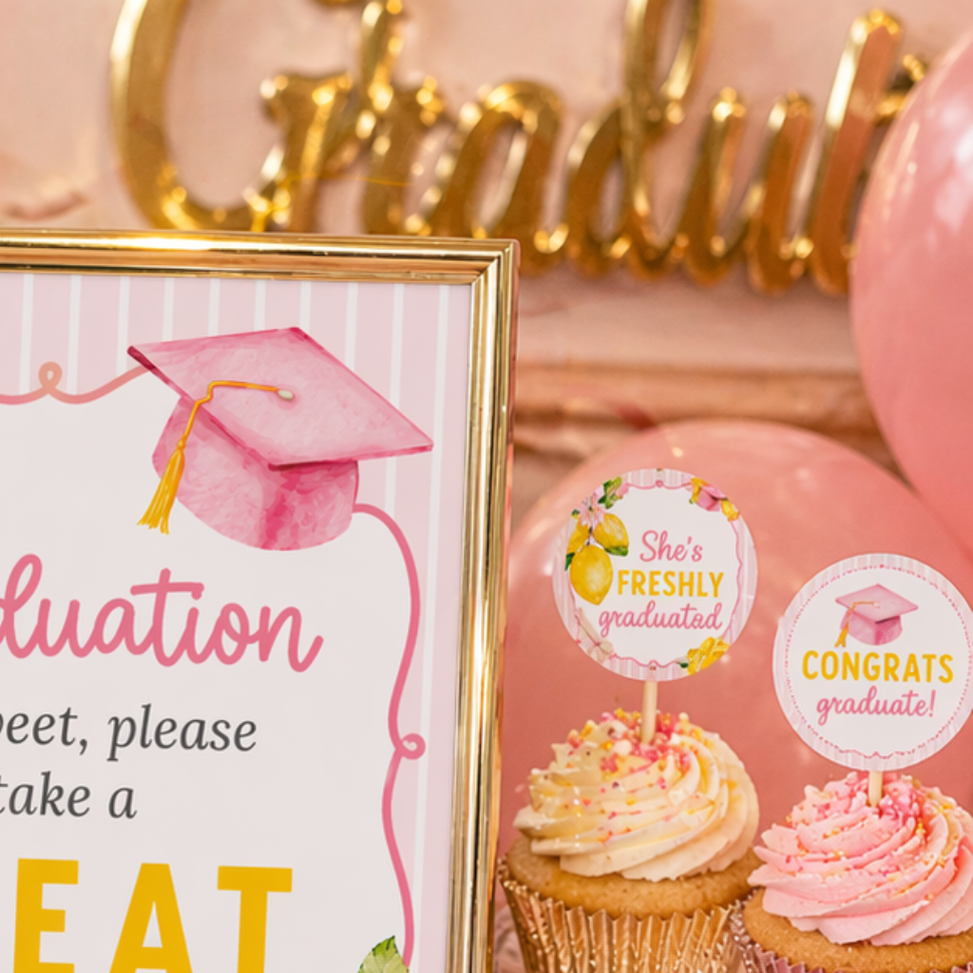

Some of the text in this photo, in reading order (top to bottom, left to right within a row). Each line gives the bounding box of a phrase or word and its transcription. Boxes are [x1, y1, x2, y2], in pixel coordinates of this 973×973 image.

[640, 530, 702, 562] She's
[617, 569, 724, 598] FRESHLY
[802, 650, 954, 684] CONGRATS
[817, 686, 936, 725] graduate!
[107, 703, 256, 762] please
[109, 788, 137, 819] a
